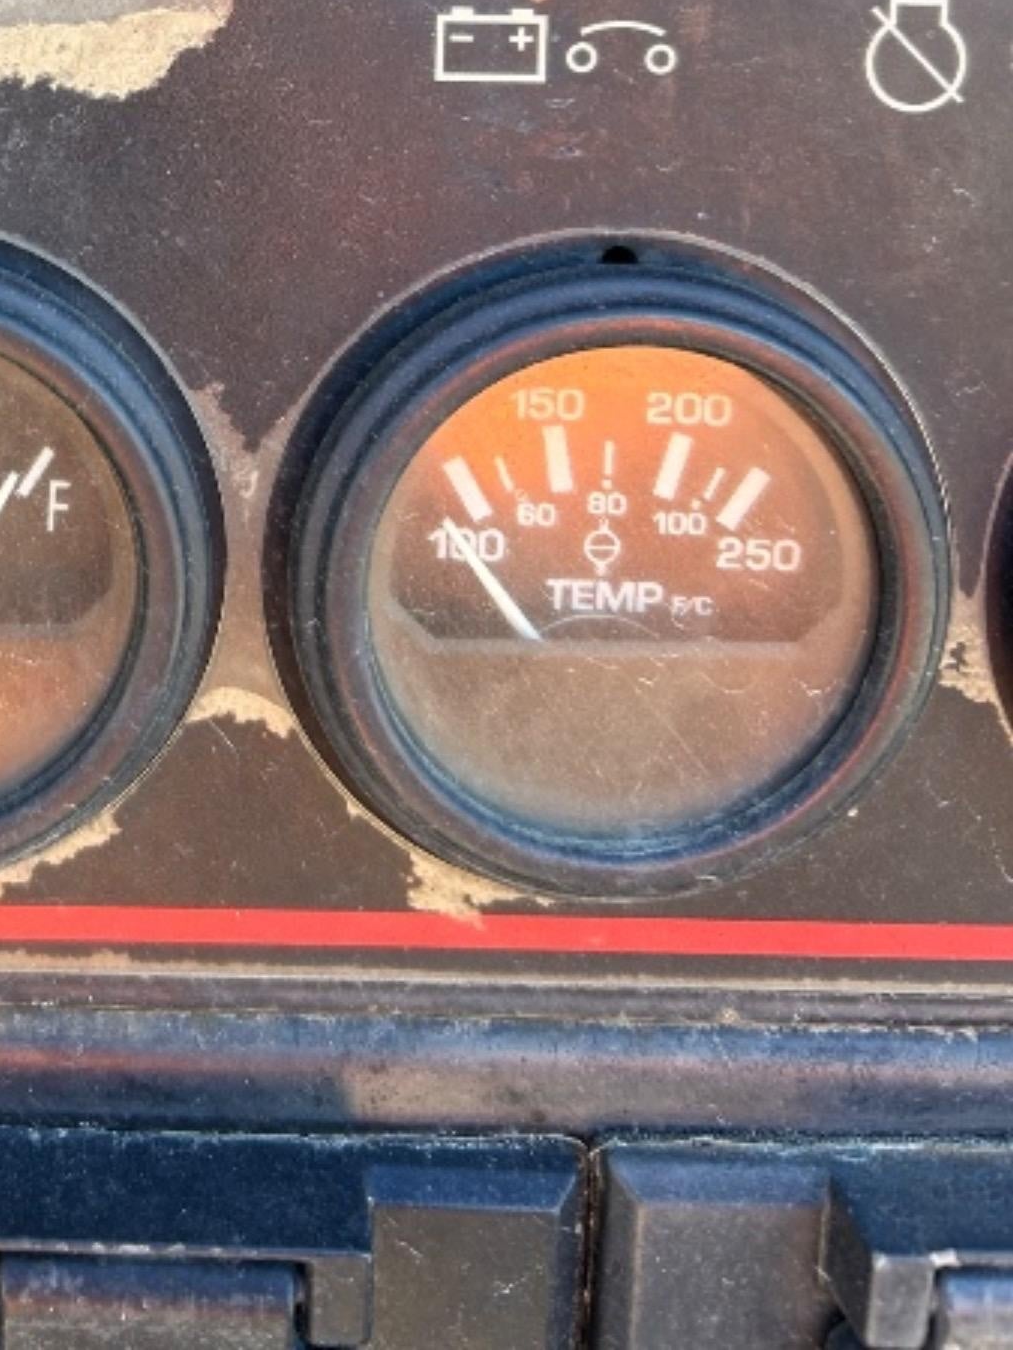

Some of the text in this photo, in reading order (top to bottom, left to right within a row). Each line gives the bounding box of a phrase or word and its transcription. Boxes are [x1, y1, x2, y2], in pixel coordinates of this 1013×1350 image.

[510, 388, 585, 422] 150
[646, 392, 733, 427] 200
[46, 480, 70, 531] F
[516, 503, 556, 527] 60
[587, 492, 627, 516] 80
[653, 511, 707, 536] 100
[716, 536, 801, 571] 250
[546, 578, 664, 613] TEMP
